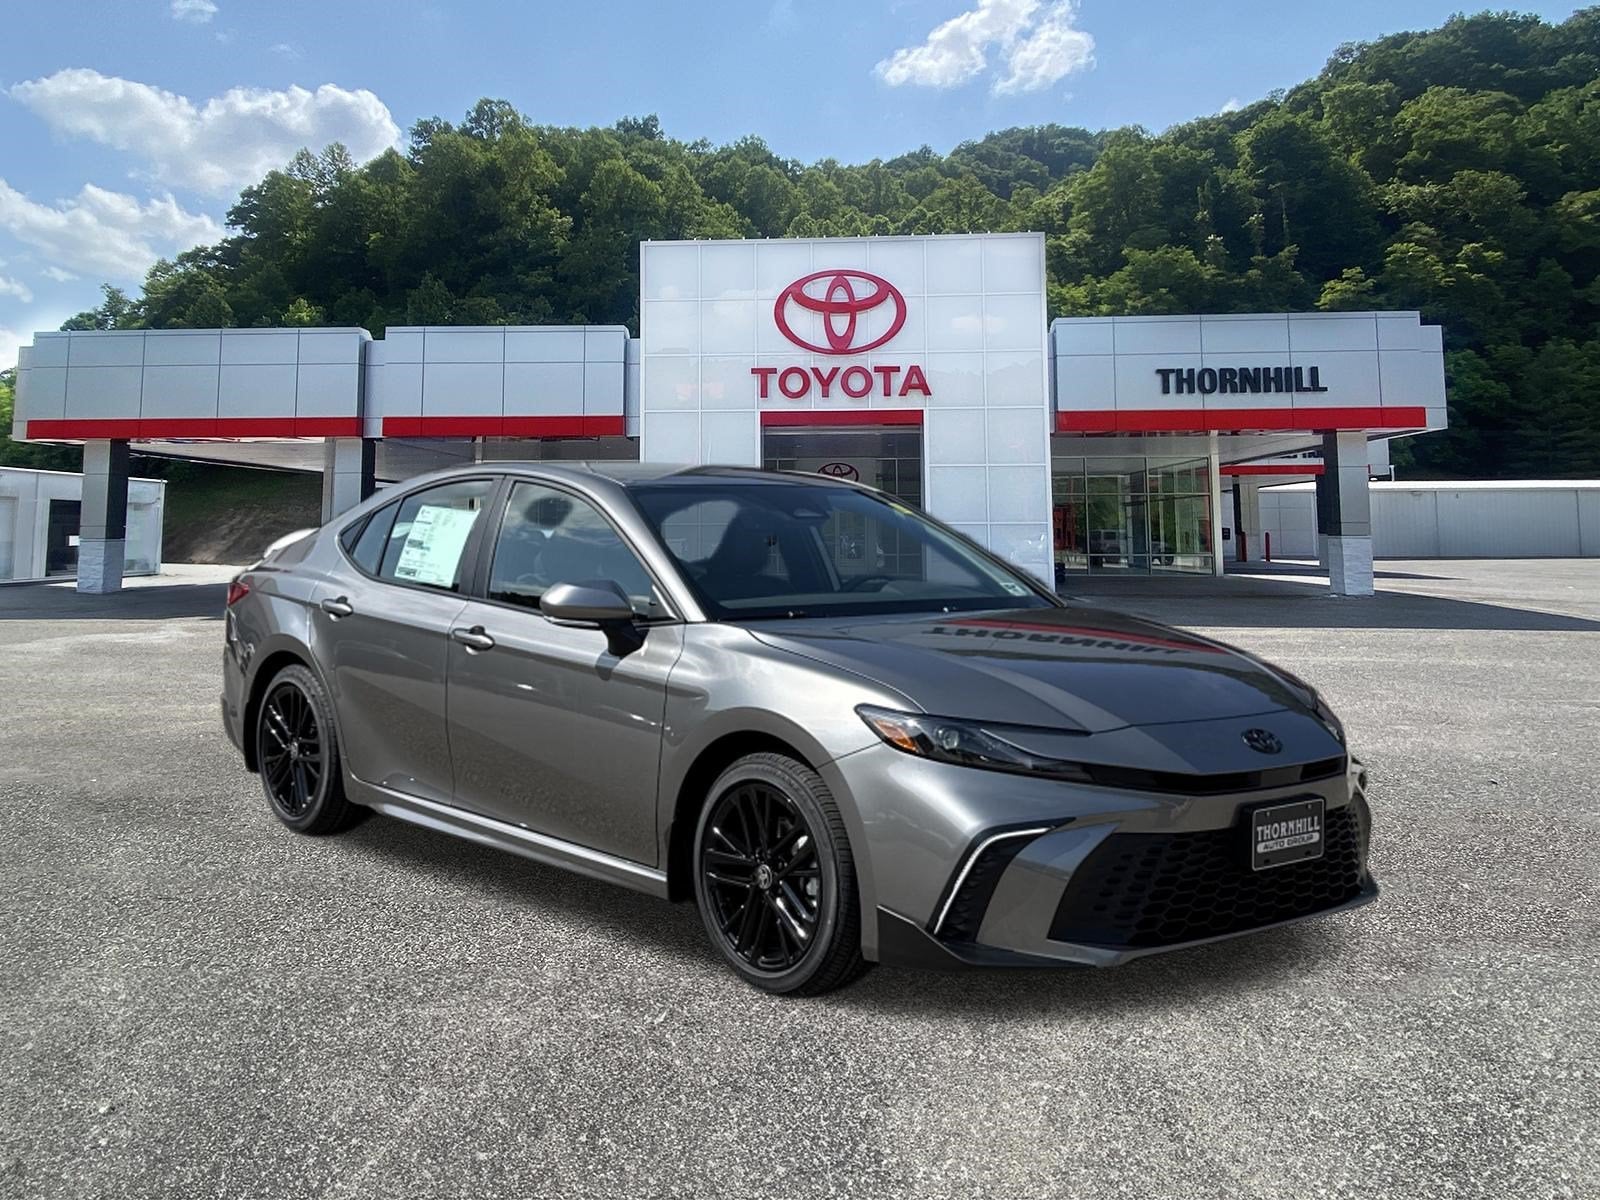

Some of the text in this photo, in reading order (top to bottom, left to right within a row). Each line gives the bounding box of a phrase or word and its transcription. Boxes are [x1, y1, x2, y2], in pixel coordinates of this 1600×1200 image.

[751, 365, 932, 399] TOYOTA
[1155, 366, 1328, 394] THORNHILL
[1256, 816, 1320, 841] THORNHILL
[1263, 840, 1285, 850] AUTO
